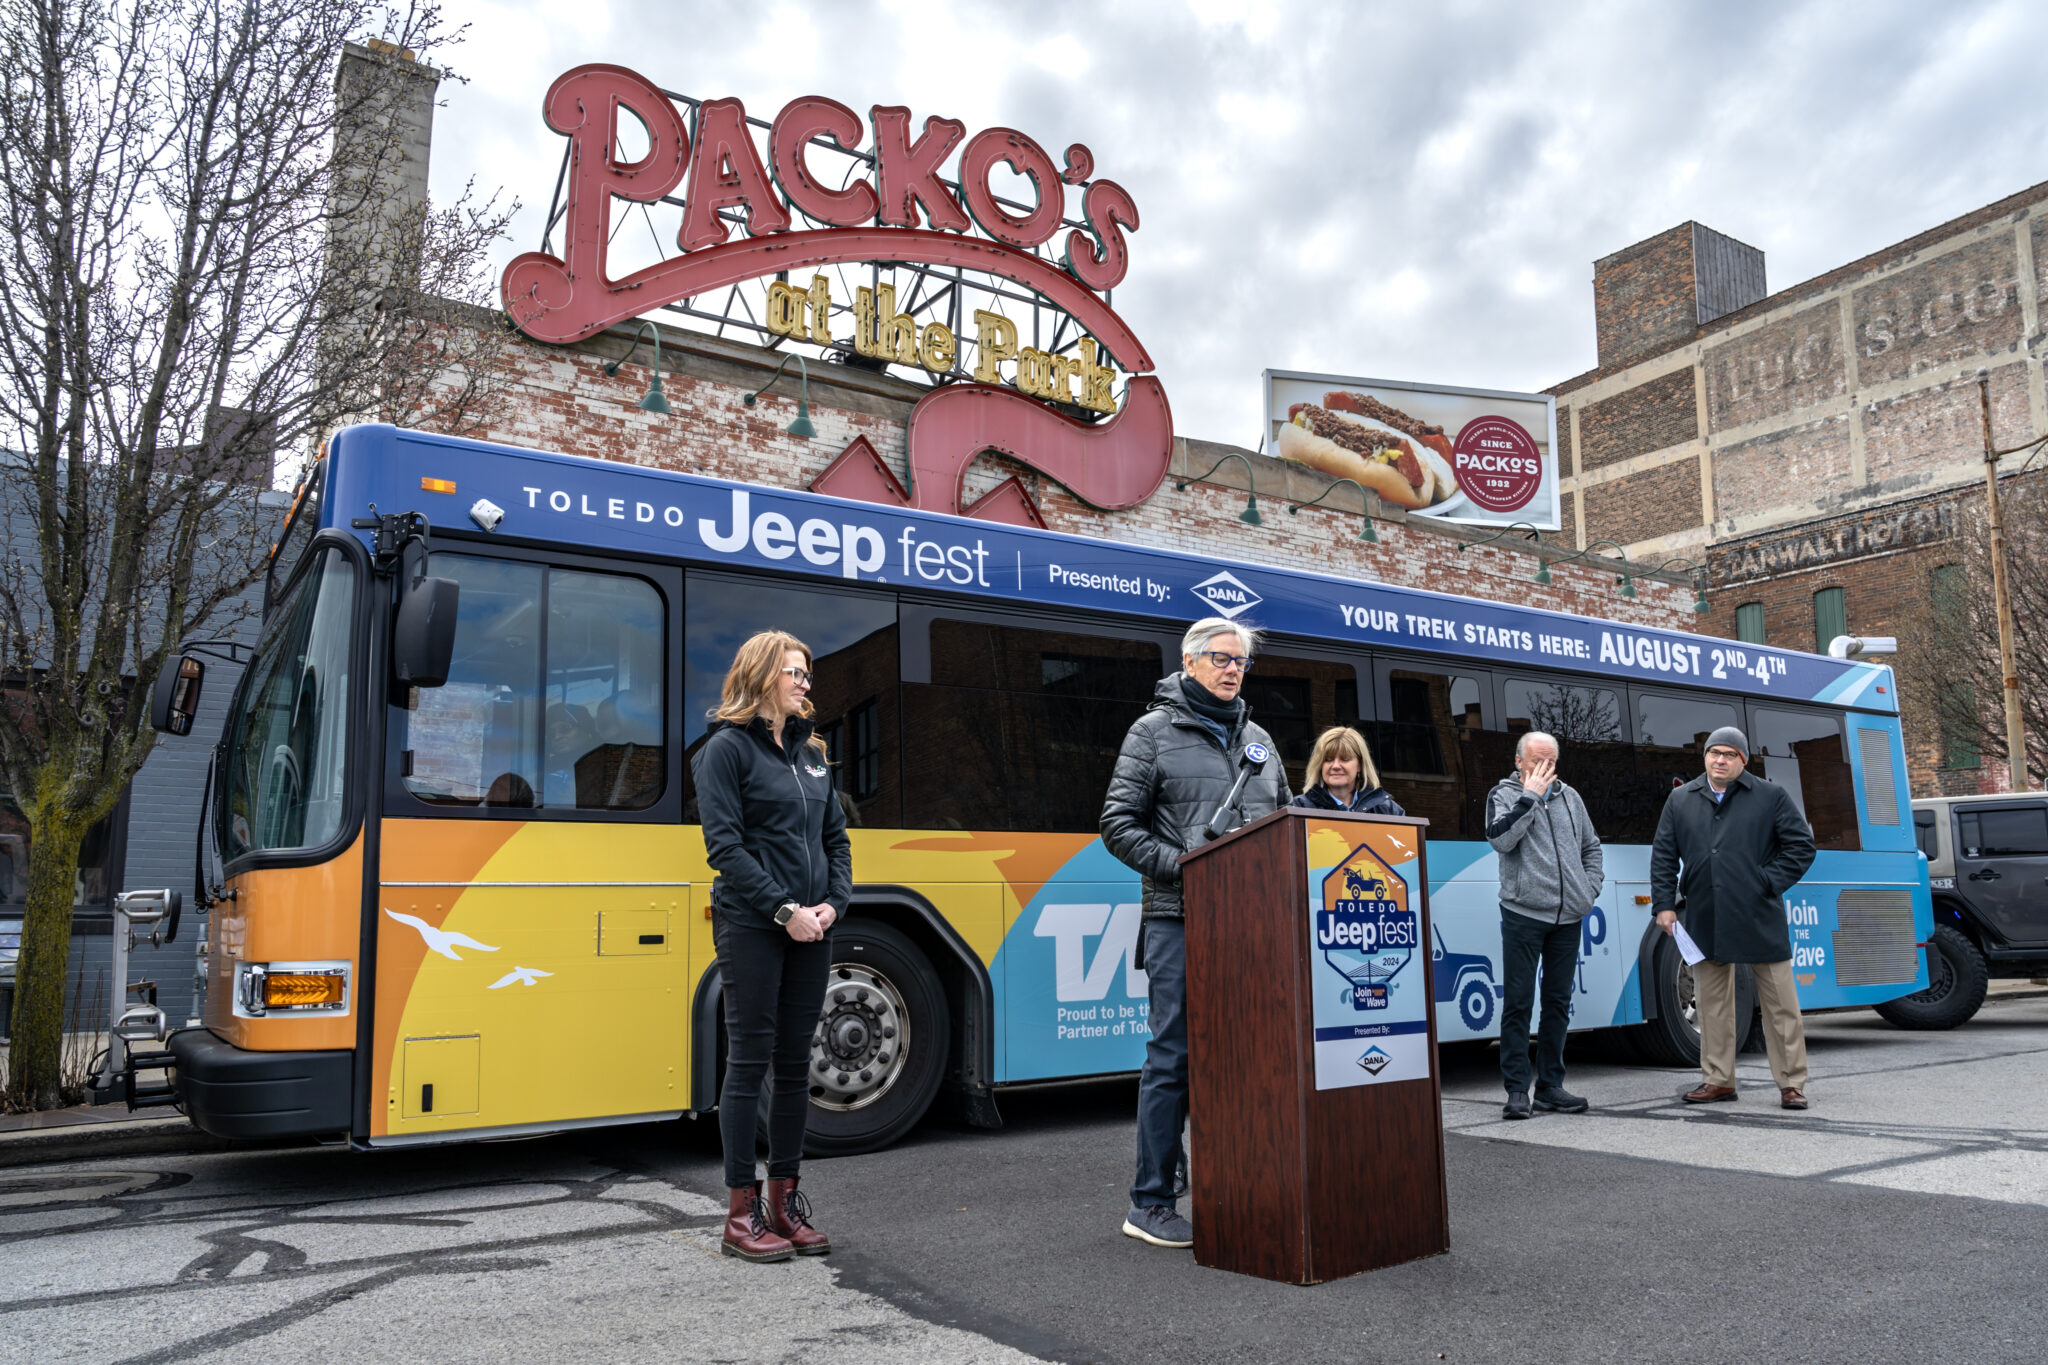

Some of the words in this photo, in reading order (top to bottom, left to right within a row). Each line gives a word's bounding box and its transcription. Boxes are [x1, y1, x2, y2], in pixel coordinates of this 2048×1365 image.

[501, 62, 1140, 345] PACKO'S
[766, 274, 832, 346] at
[853, 282, 956, 373] the
[974, 309, 1117, 414] Park
[1481, 440, 1513, 449] SINCE
[1456, 453, 1538, 475] PACKO'S
[1487, 480, 1510, 488] 1932
[523, 486, 684, 527] TOLEDO
[699, 490, 886, 580] Jeep
[898, 527, 990, 587] fest
[1049, 564, 1140, 596] Presented
[1147, 580, 1171, 602] by:
[1207, 586, 1246, 603] DANA
[1340, 604, 1399, 635] YOUR
[1405, 614, 1458, 641] TREK
[1464, 624, 1533, 651] STARTS
[1540, 634, 1590, 659] HERE:
[1600, 631, 1701, 676] AUGUST
[1250, 745, 1266, 759] 13
[1338, 902, 1396, 913] TOLEDO
[1786, 899, 1818, 926] Join
[1319, 914, 1377, 951] Jeep
[1378, 915, 1415, 944] fest
[1795, 929, 1810, 939] THE
[1383, 958, 1399, 966] 2024
[1355, 987, 1372, 998] Join
[1367, 997, 1386, 1007] Wave
[1058, 1006, 1096, 1022] Proud
[1101, 1006, 1114, 1019] to
[1119, 1005, 1134, 1018] be
[1058, 1024, 1108, 1039] Partner
[1113, 1022, 1125, 1035] of
[1354, 1026, 1381, 1035] Presented
[1364, 1056, 1384, 1065] DANA
